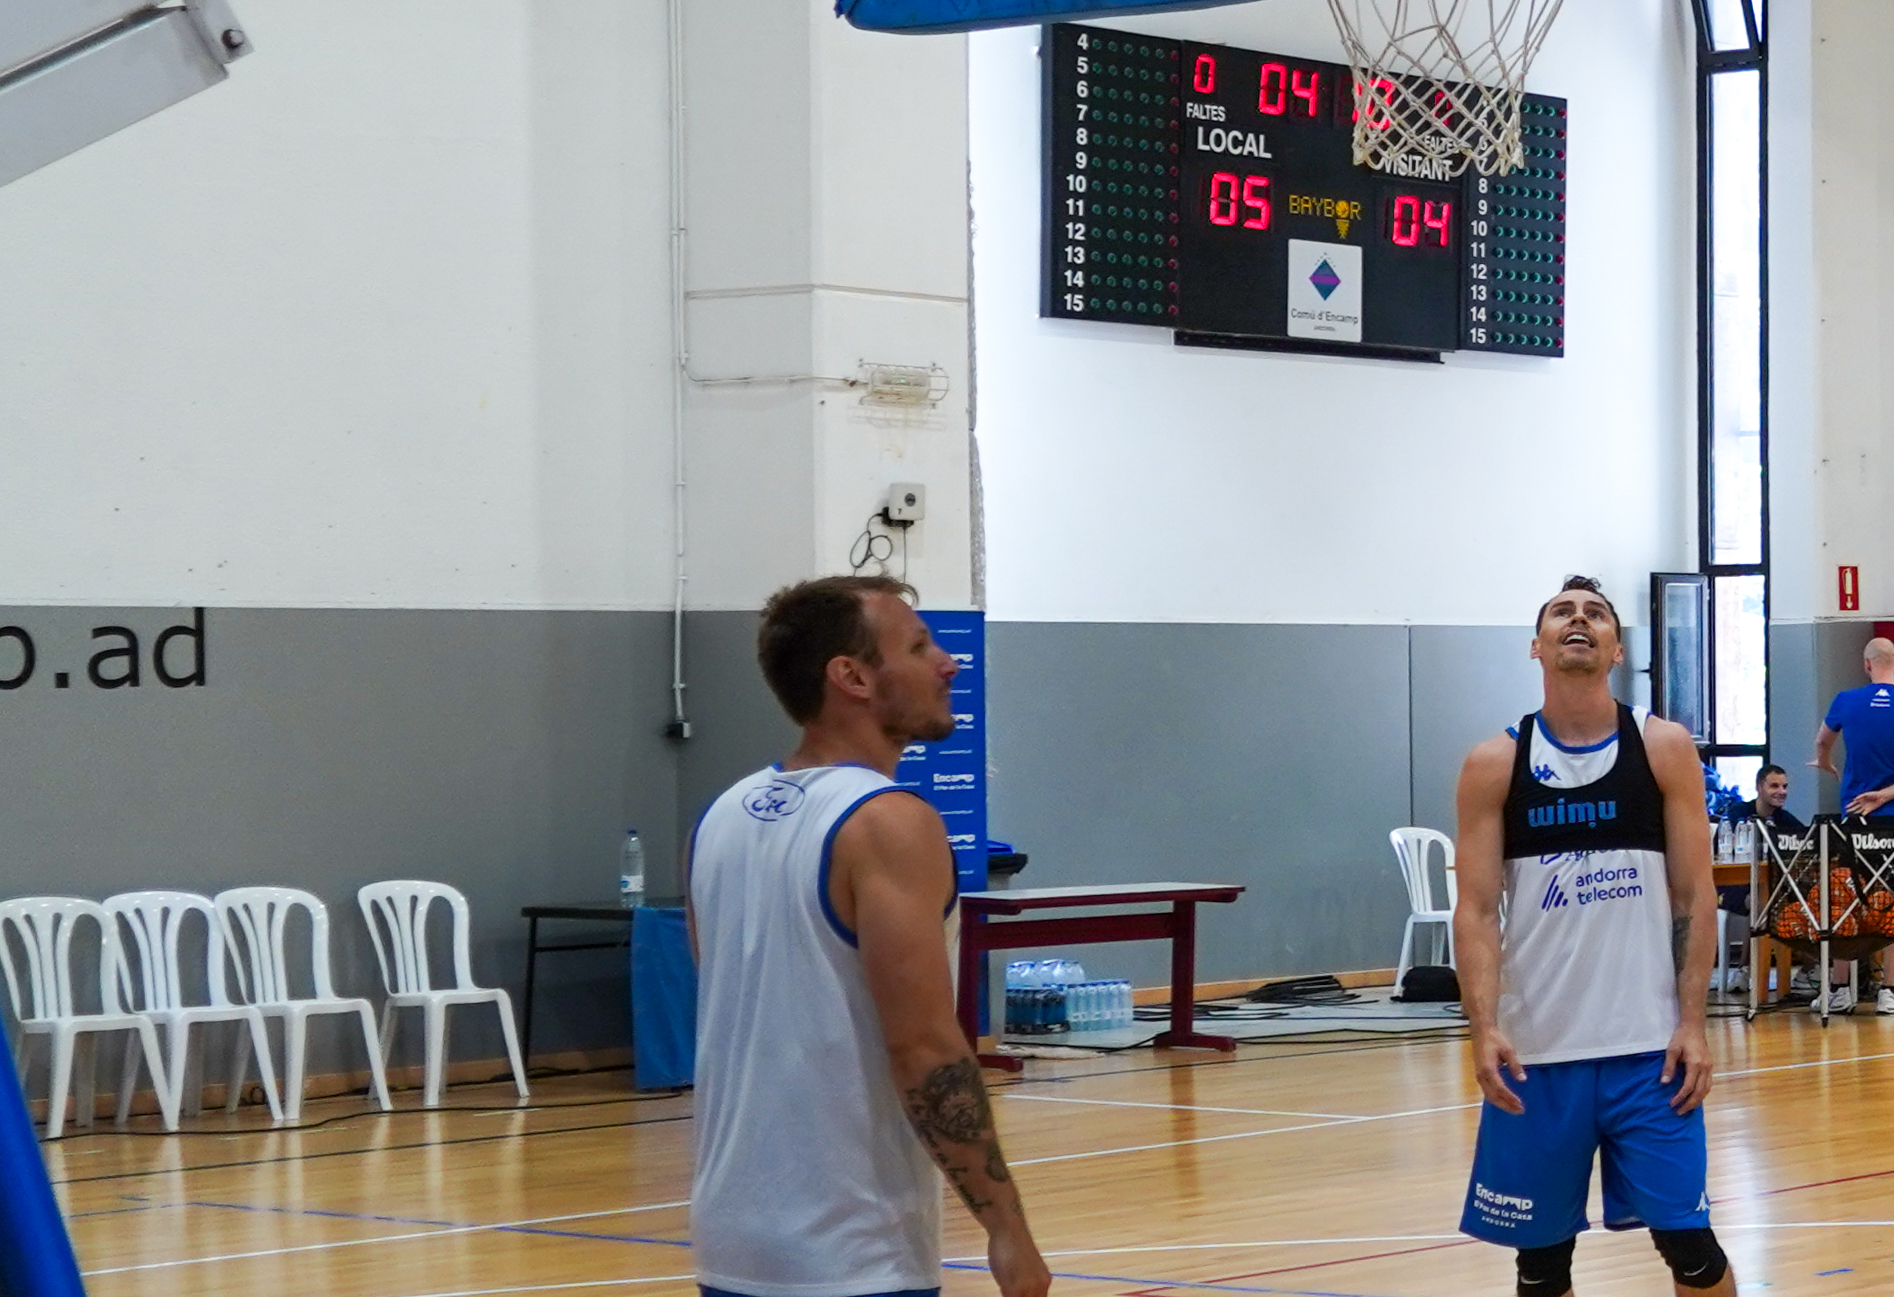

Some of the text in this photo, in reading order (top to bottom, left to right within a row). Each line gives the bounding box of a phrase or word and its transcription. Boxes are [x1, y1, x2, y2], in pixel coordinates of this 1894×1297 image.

[1077, 33, 1088, 50] 4
[1077, 56, 1088, 73] 5
[1193, 53, 1216, 93] 0
[1076, 80, 1088, 98] 6
[1258, 61, 1319, 117] 04
[1077, 104, 1088, 120] 7
[1186, 102, 1226, 122] FALTES
[1076, 127, 1088, 145] 8
[1197, 126, 1272, 158] LOCAL
[1075, 151, 1087, 169] 9
[1383, 154, 1453, 182] VISITANT
[1066, 174, 1087, 193] 10
[1478, 178, 1488, 192] 8
[1066, 198, 1085, 216] 11
[1209, 172, 1271, 230] 05
[1478, 200, 1487, 215] 9
[1392, 195, 1450, 246] 04
[1471, 221, 1487, 236] 10
[1065, 222, 1086, 240] 12
[1065, 245, 1085, 264] 13
[1471, 242, 1486, 257] 11
[1064, 270, 1084, 288] 14
[1471, 264, 1487, 279] 12
[1064, 293, 1084, 312] 15
[1471, 286, 1487, 301] 13
[1470, 307, 1486, 322] 14
[1470, 329, 1486, 344] 15
[1778, 834, 1814, 851] Wilso
[1576, 867, 1638, 888] andorra
[1577, 885, 1643, 905] telecom
[1476, 1182, 1534, 1211] Encamp
[1510, 1212, 1533, 1221] Casa
